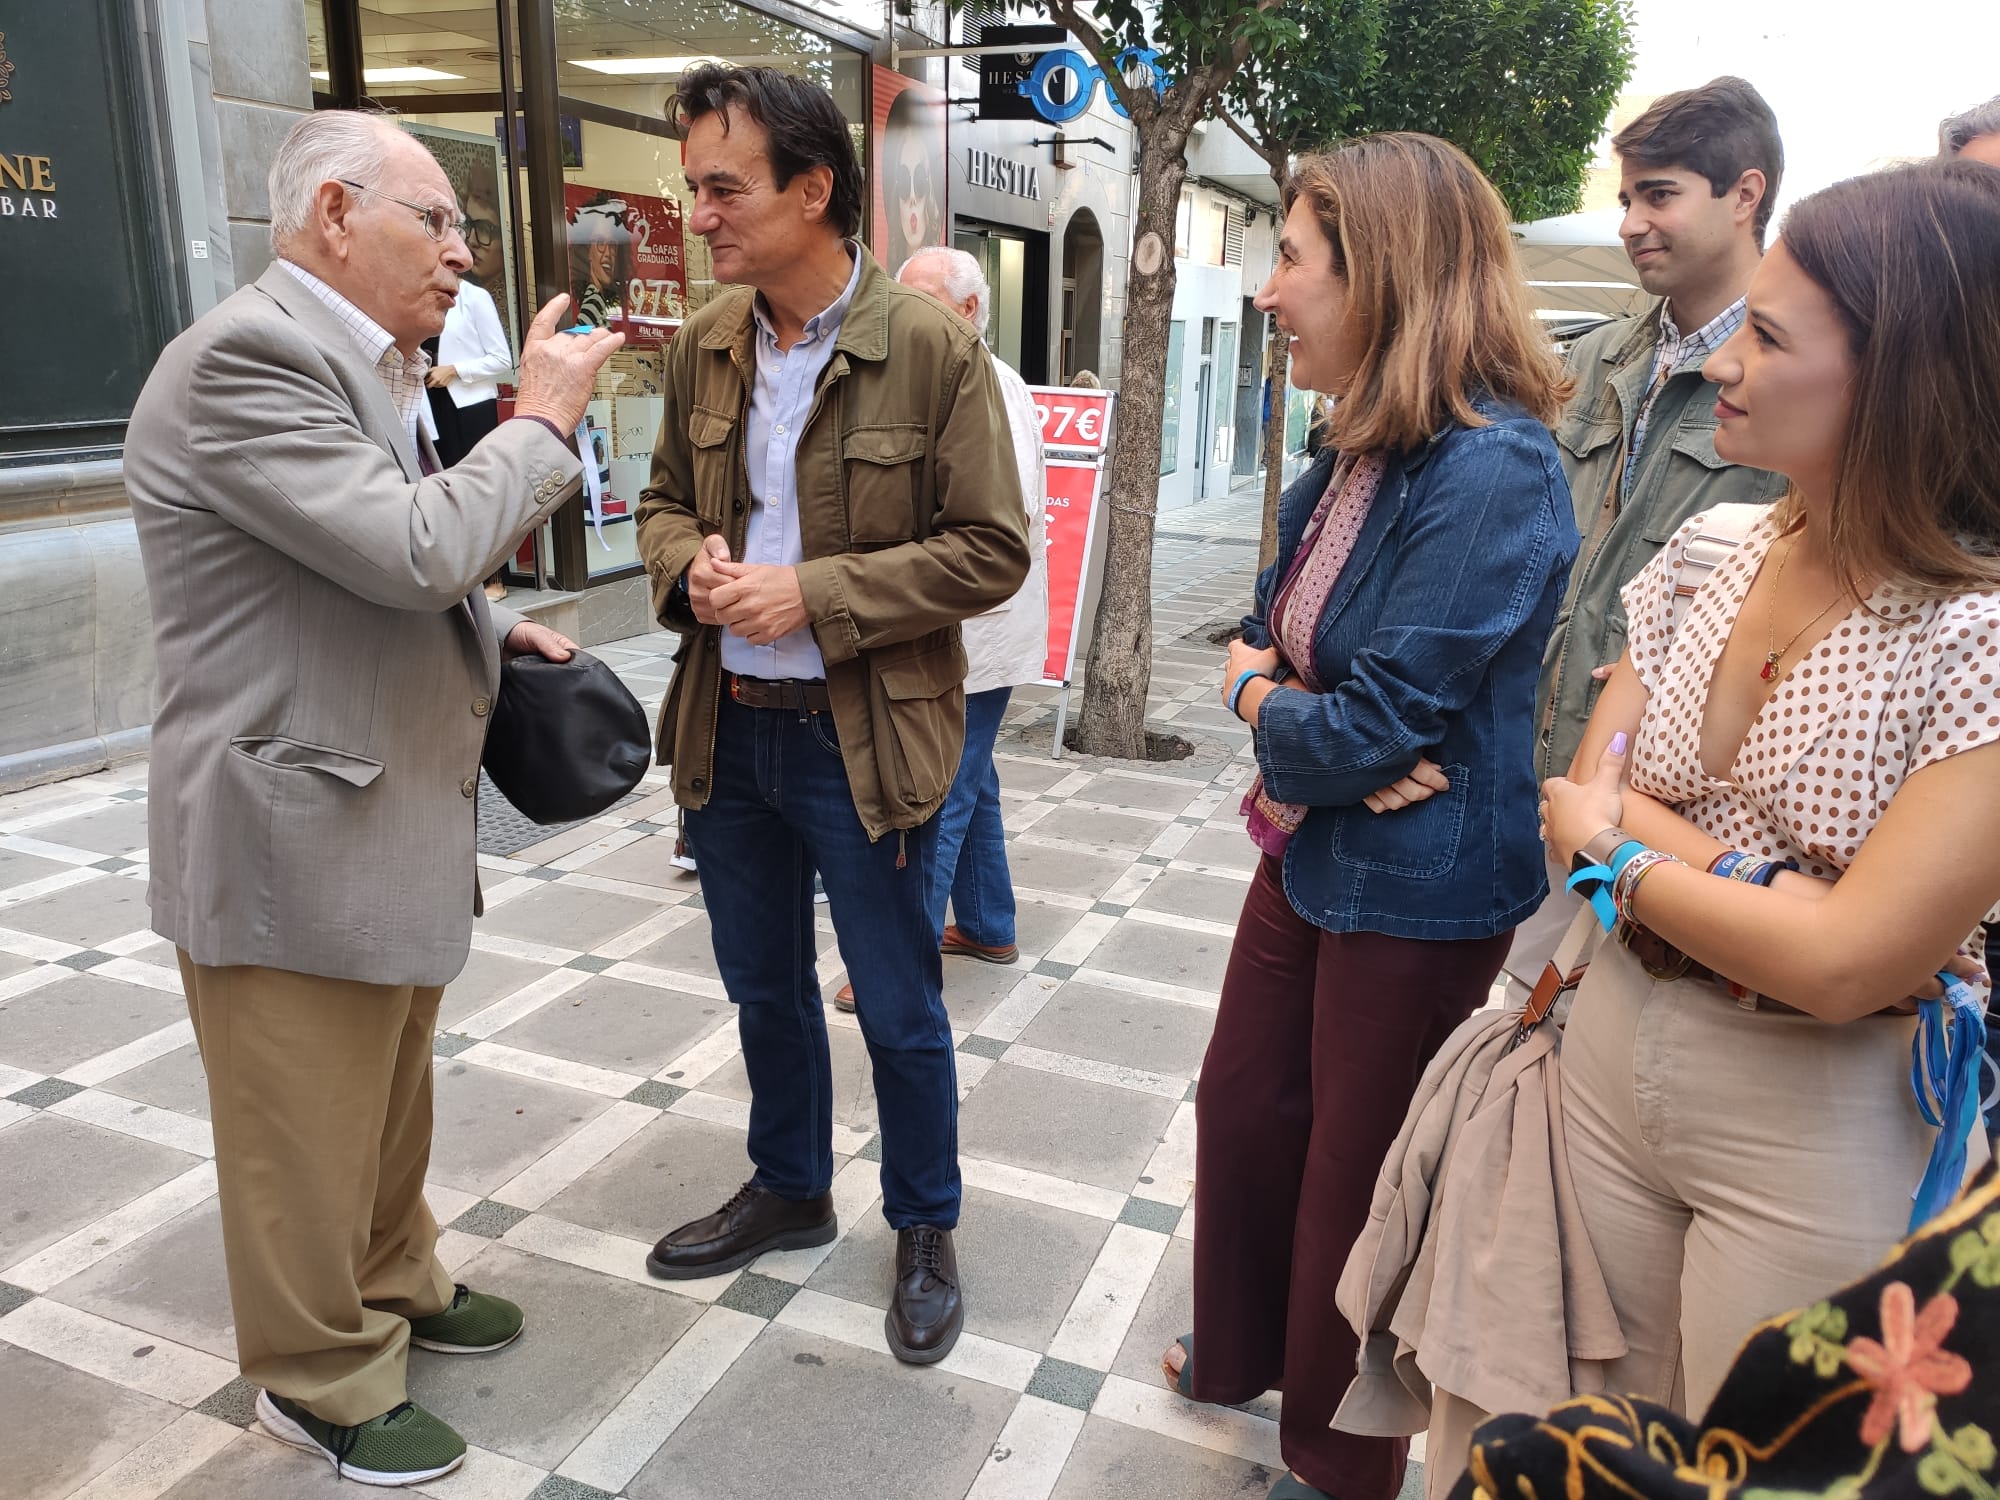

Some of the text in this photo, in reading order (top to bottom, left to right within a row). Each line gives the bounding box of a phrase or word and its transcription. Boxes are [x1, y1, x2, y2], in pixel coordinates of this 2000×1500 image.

[968, 147, 1041, 200] HESTIA
[0, 195, 57, 219] BAR
[637, 218, 679, 256] 2 GAFAS
[637, 253, 680, 266] GRADUADAS
[629, 278, 683, 319] 97€
